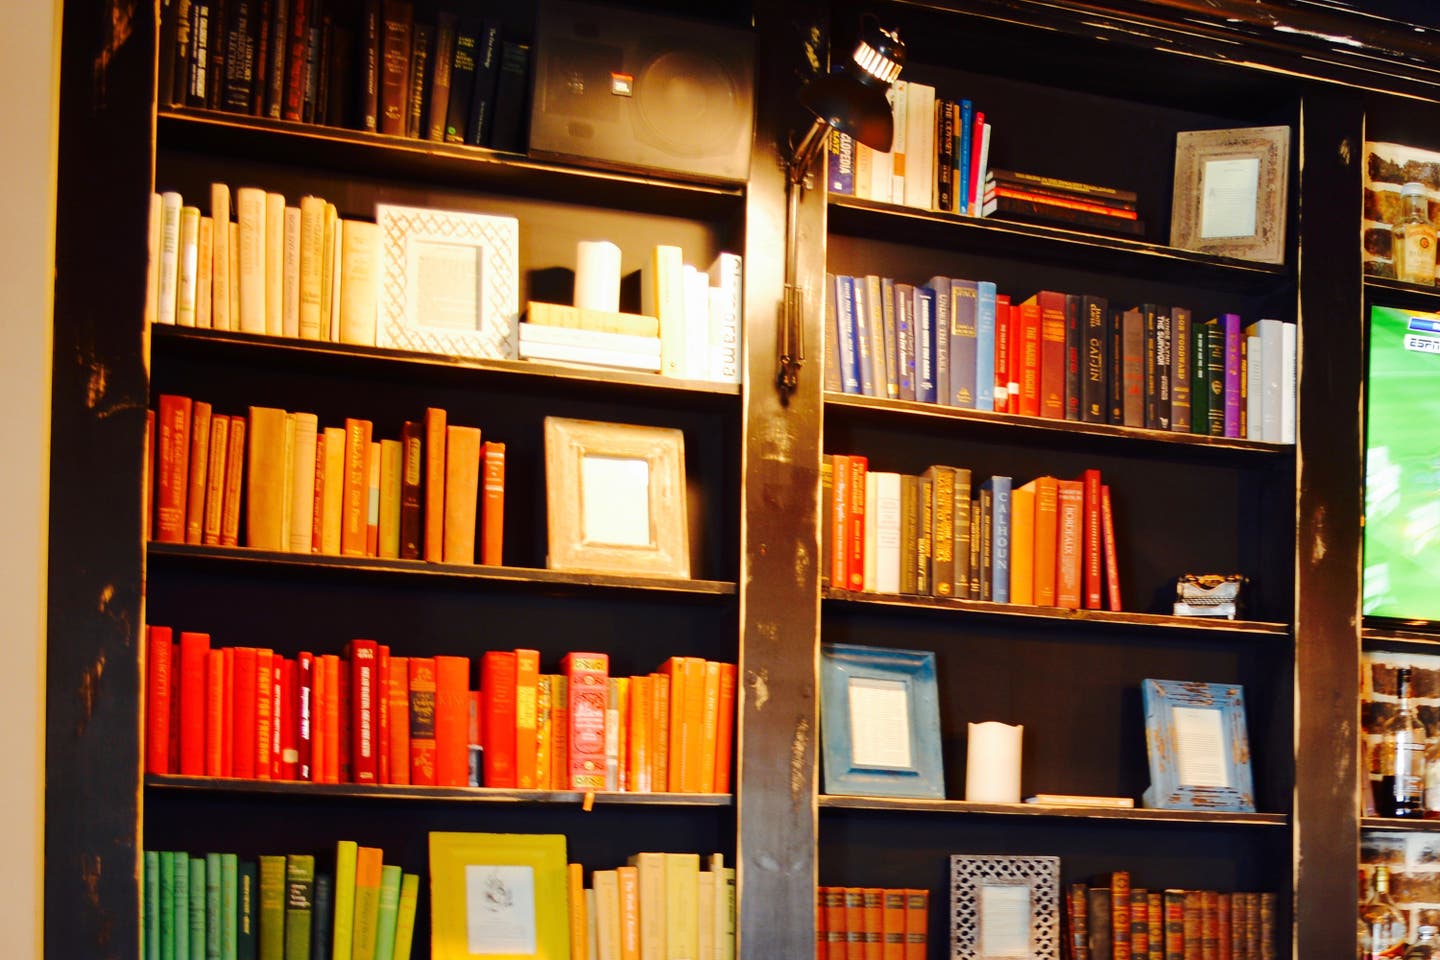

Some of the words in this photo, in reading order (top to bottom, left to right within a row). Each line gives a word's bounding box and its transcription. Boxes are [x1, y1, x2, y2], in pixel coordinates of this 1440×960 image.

[944, 103, 952, 118] THE
[943, 121, 953, 155] ODYSSEY
[938, 293, 948, 325] UNDER
[1157, 315, 1165, 329] THE
[938, 328, 948, 346] THE
[1026, 327, 1036, 339] THE
[1410, 338, 1440, 350] ESPN
[938, 348, 948, 373] LAKE
[1026, 342, 1036, 367] NAKED
[1157, 330, 1165, 366] SURVIVOR
[1025, 369, 1036, 399] SOCIETY
[997, 491, 1009, 569] CALHOUN
[1063, 506, 1076, 554] BORDEAUX
[258, 667, 270, 695] FIGHT
[258, 698, 270, 716] FOR
[257, 719, 270, 763] FREEDOM
